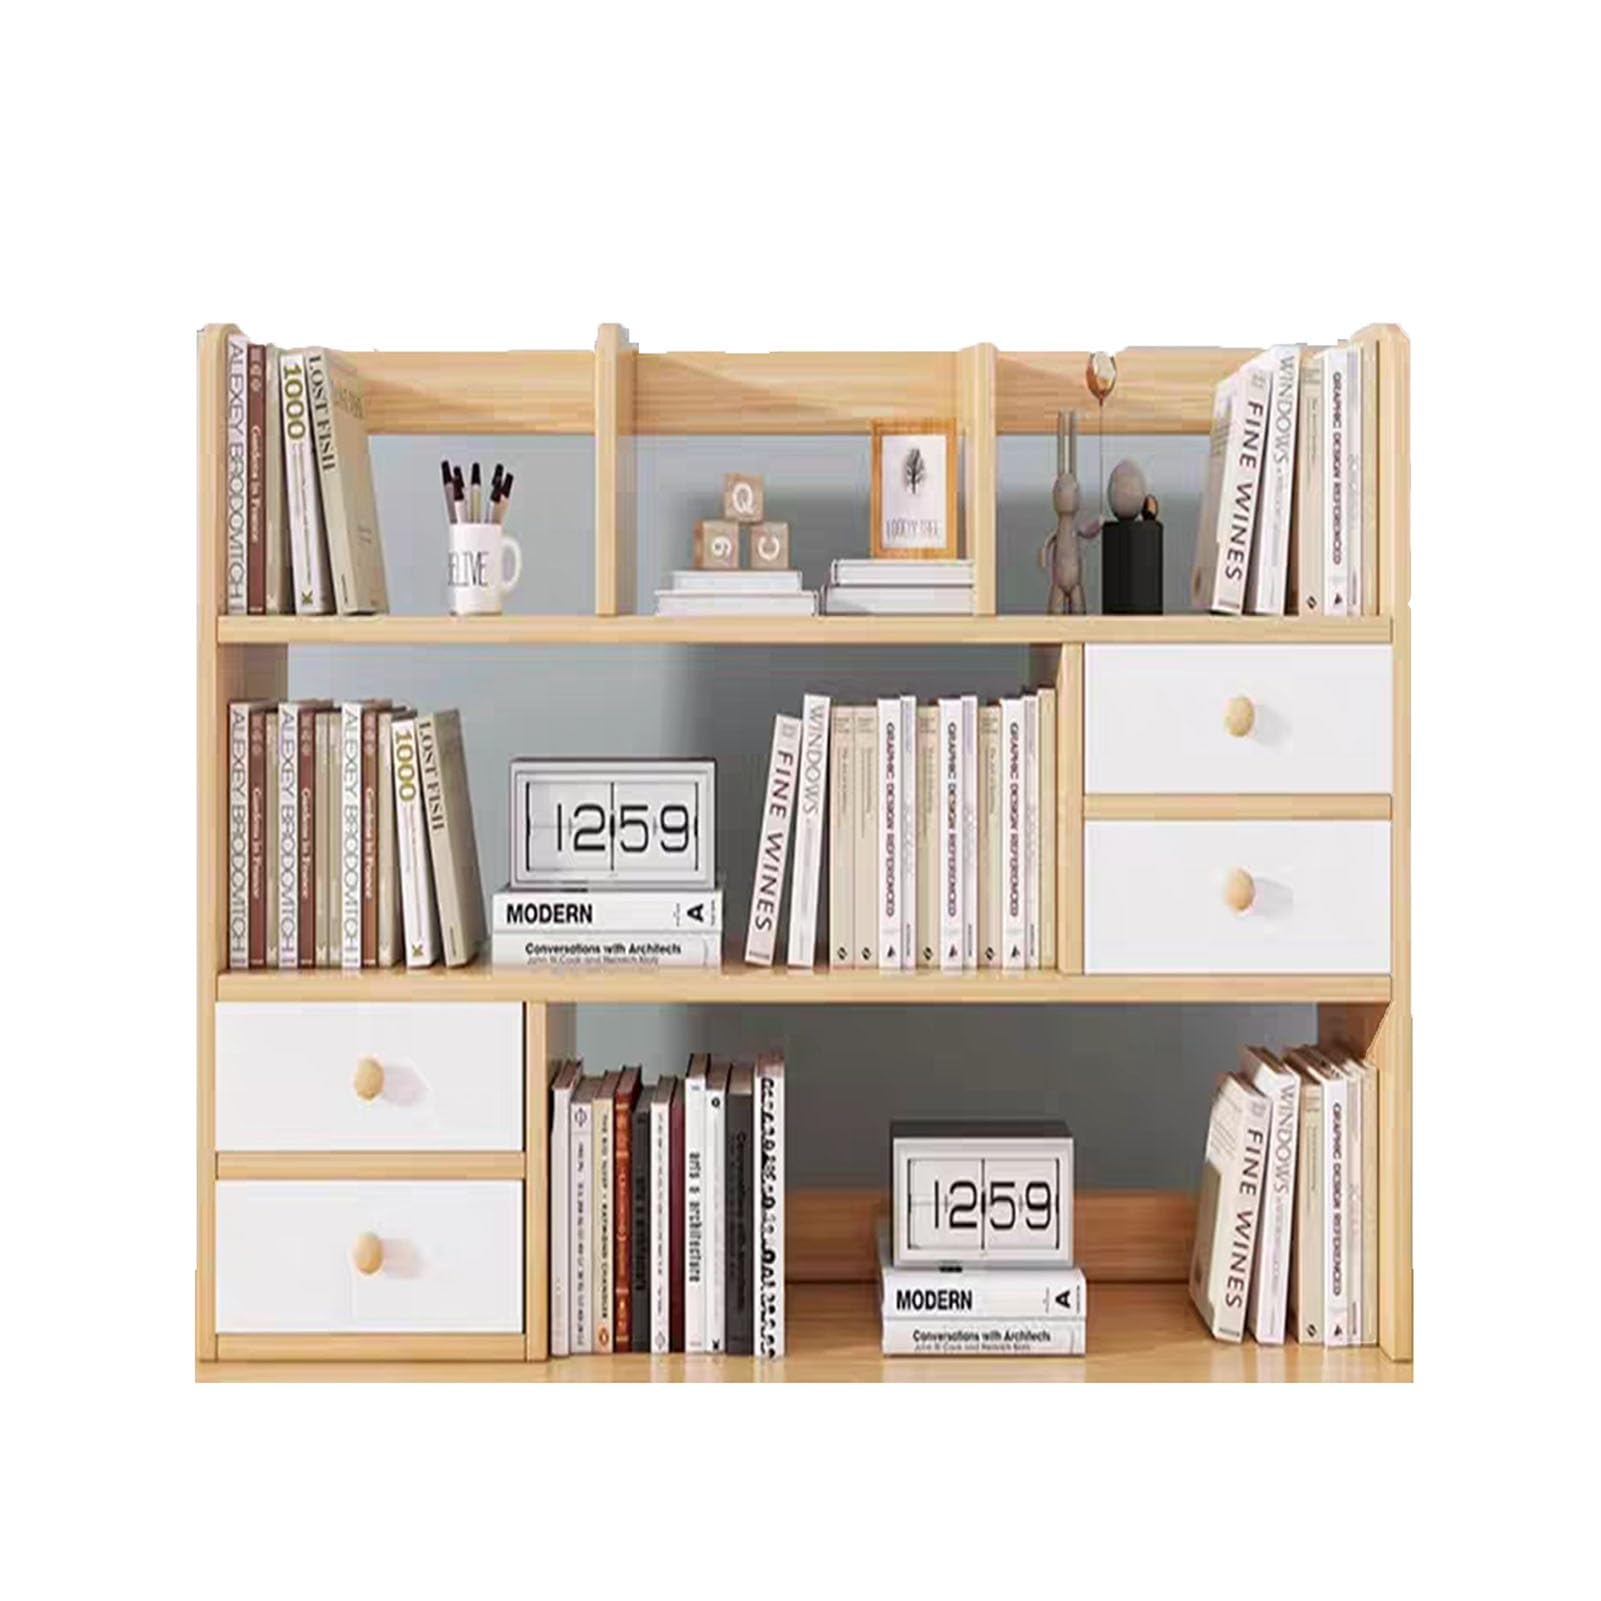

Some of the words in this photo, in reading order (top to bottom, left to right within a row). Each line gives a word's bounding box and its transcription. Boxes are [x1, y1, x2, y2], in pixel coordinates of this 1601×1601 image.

[229, 343, 244, 434] ALEXEY
[283, 364, 306, 440] 1000
[309, 355, 327, 415] LOST
[1273, 355, 1295, 465] WINDOWS
[1332, 372, 1342, 429] GRAPHIC
[315, 418, 335, 471] FISH
[1240, 400, 1264, 469] FINE
[1332, 432, 1342, 478] DESIGN
[732, 483, 755, 514] Q
[1225, 482, 1253, 581] WINES
[231, 711, 246, 797] ALEXEY
[281, 711, 295, 797] ALEXEY
[344, 711, 359, 797] ALEXEY
[395, 730, 416, 802] 1000
[419, 721, 437, 777] LOST
[802, 704, 824, 815] WINDOWS
[886, 722, 895, 779] GRAPHIC
[948, 722, 957, 779] GRAPHIC
[1009, 722, 1019, 779] GRAPHIC
[427, 781, 445, 830] FISH
[769, 749, 793, 819] FINE
[886, 783, 895, 829] DESIGN
[948, 783, 957, 829] DESIGN
[1009, 783, 1019, 829] DESIGN
[557, 803, 606, 852] 12
[620, 804, 690, 853] 59
[755, 832, 783, 932] WINES
[506, 903, 593, 924] MODERN
[686, 903, 704, 922] A
[525, 942, 600, 955] Conversations
[603, 942, 626, 954] with
[628, 942, 682, 955] Architects
[1273, 1085, 1295, 1194] WINDOWS
[1332, 1102, 1342, 1159] GRAPHIC
[689, 1152, 702, 1178] arts
[1239, 1128, 1263, 1196] FINE
[1332, 1163, 1342, 1208] DESIGN
[934, 1179, 978, 1229] 12
[989, 1181, 1051, 1230] 59
[688, 1201, 702, 1282] architecture
[1225, 1210, 1253, 1309] WINES
[896, 1289, 973, 1311] MODERN
[1055, 1290, 1071, 1308] A
[912, 1329, 979, 1342] Conversations
[981, 1330, 1002, 1341] with
[1004, 1330, 1051, 1341] Architects
